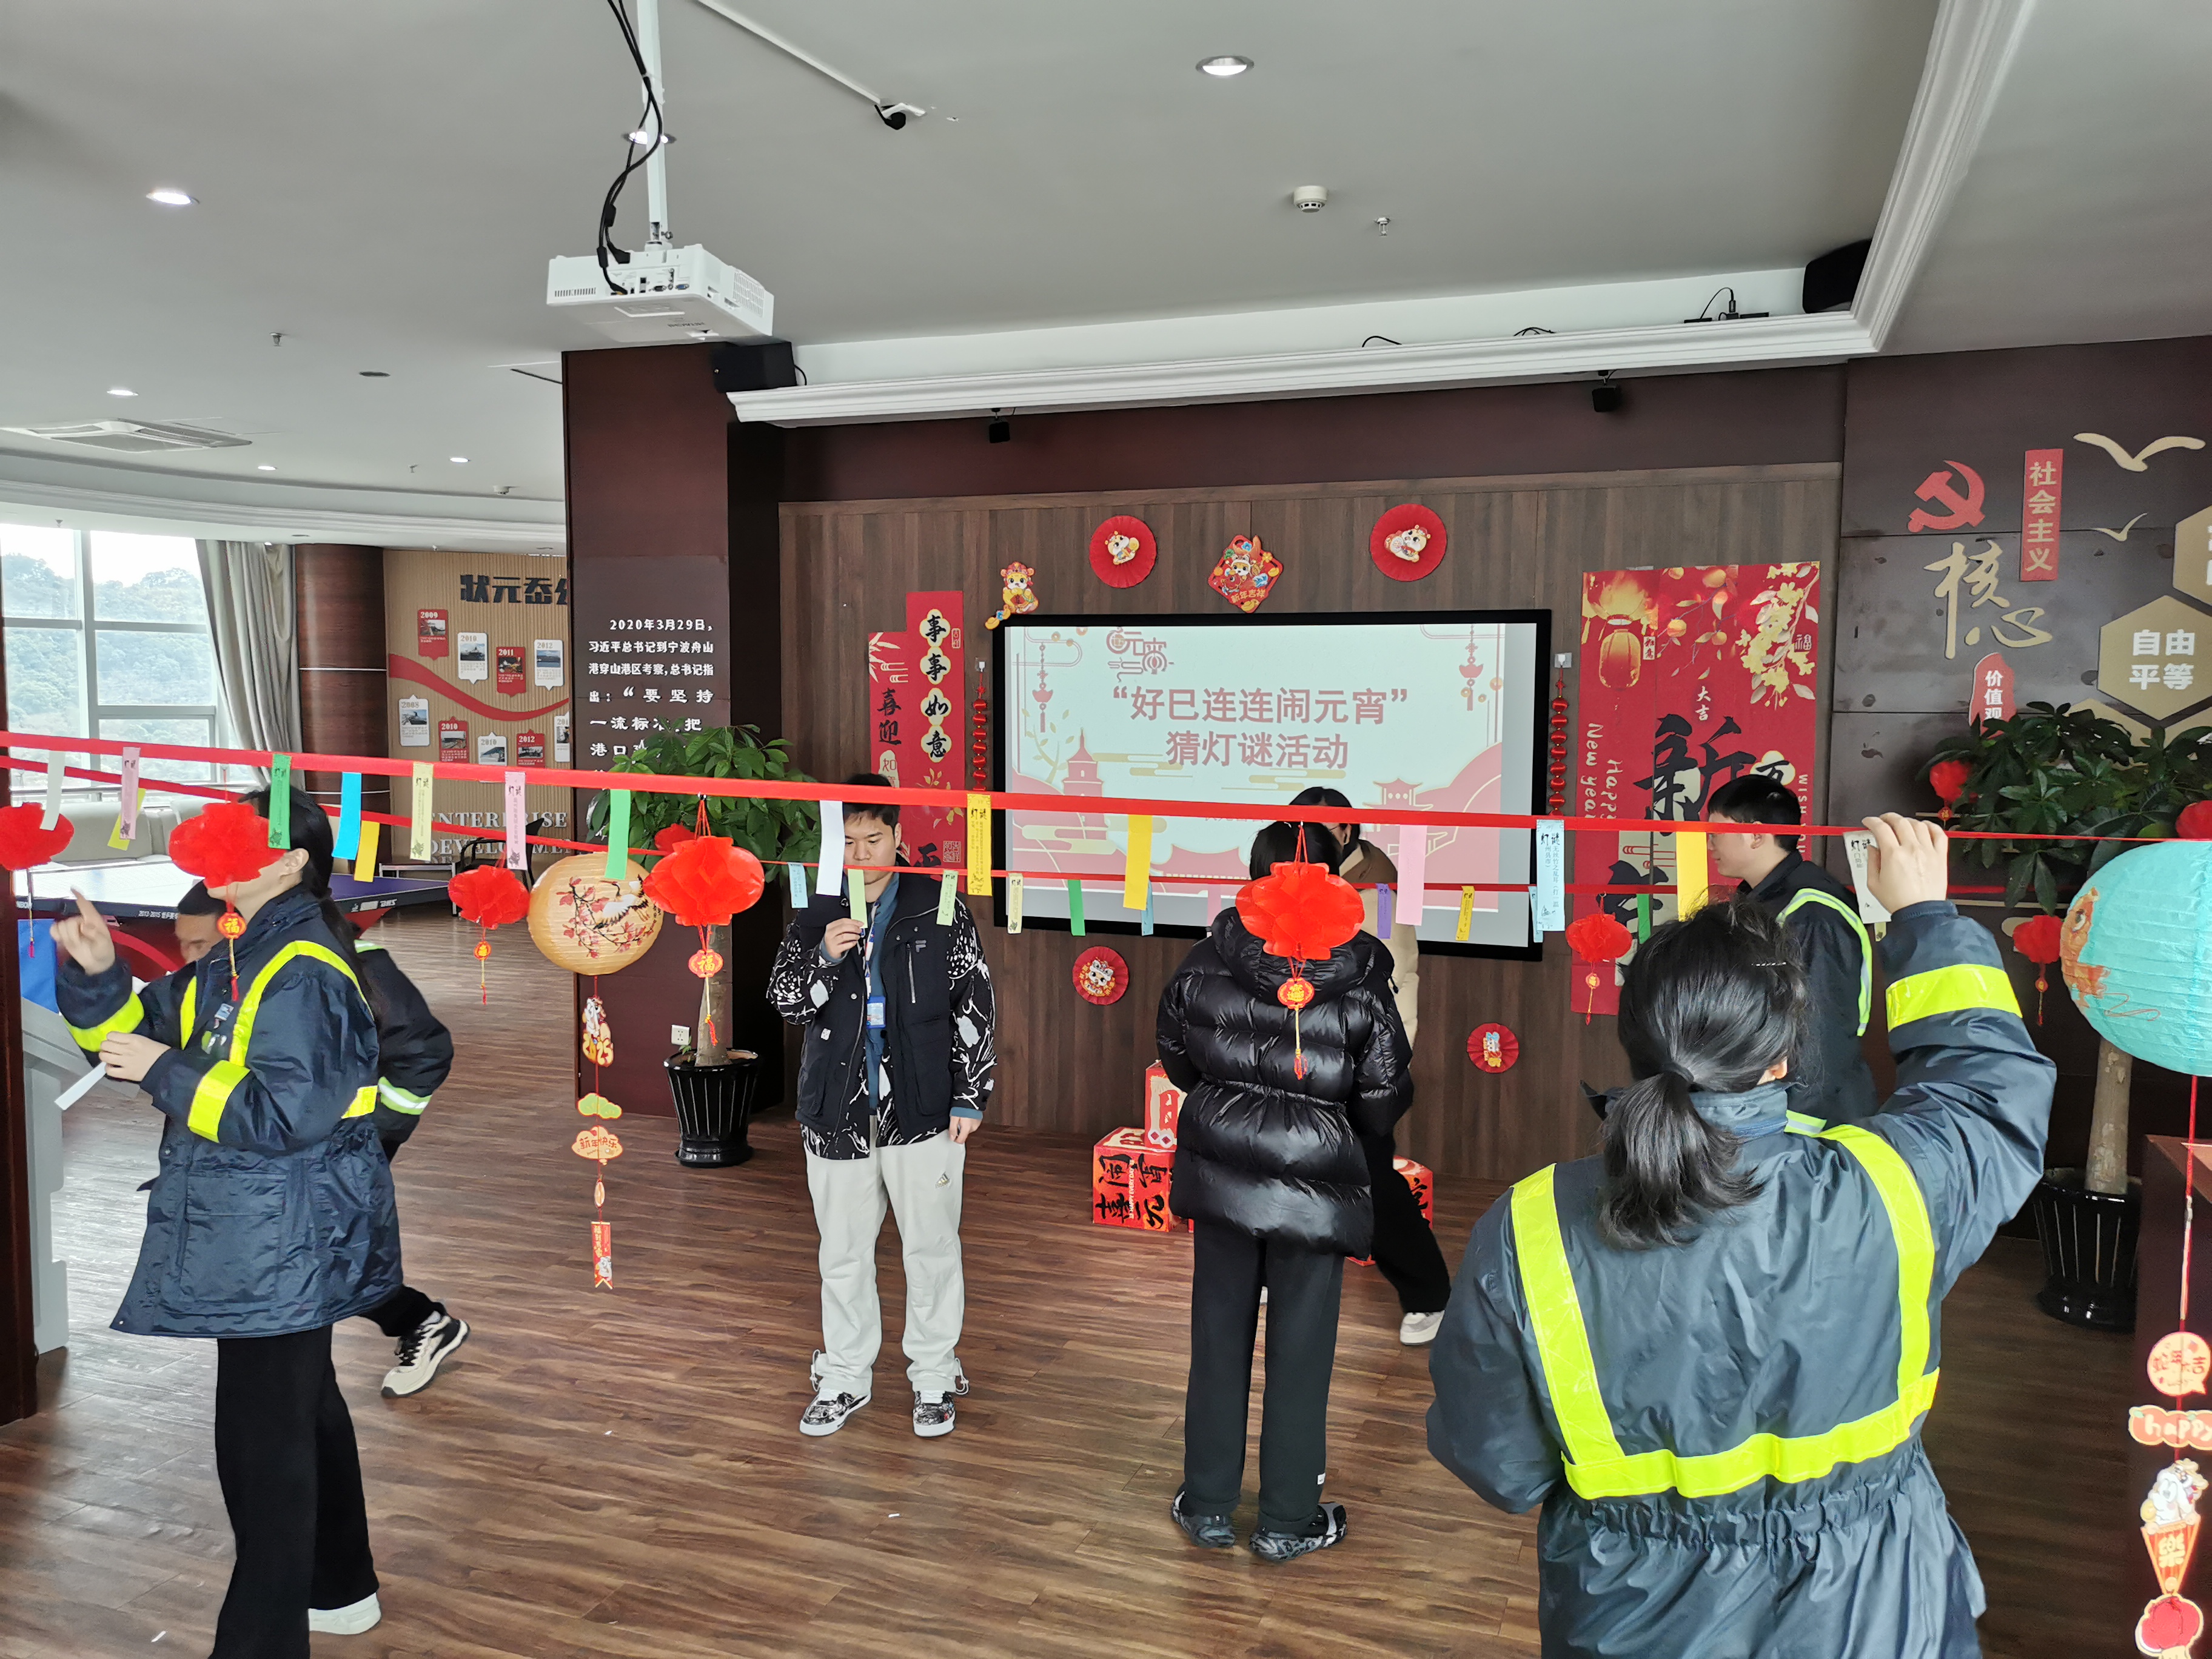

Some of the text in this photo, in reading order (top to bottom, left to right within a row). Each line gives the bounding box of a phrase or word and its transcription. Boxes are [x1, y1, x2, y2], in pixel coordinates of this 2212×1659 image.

[2025, 461, 2057, 572] 社会主义
[1923, 539, 2053, 660] 核心
[610, 618, 713, 632] 2020年3月29日，
[588, 641, 714, 654] 习近平总书记到宁波舟山
[2133, 629, 2195, 656] 自由
[925, 614, 949, 758] 事事如意
[2129, 663, 2194, 690] 平等
[877, 687, 902, 746] 喜迎
[1695, 685, 1711, 722] 大吉
[518, 735, 535, 743] 2012
[1165, 729, 1349, 769] 猜灯谜活动
[1586, 723, 1604, 766] New
[1540, 832, 1560, 846] 灯谜
[224, 917, 240, 934] 福
[697, 954, 716, 973] 福
[580, 1136, 618, 1150] 新年快乐
